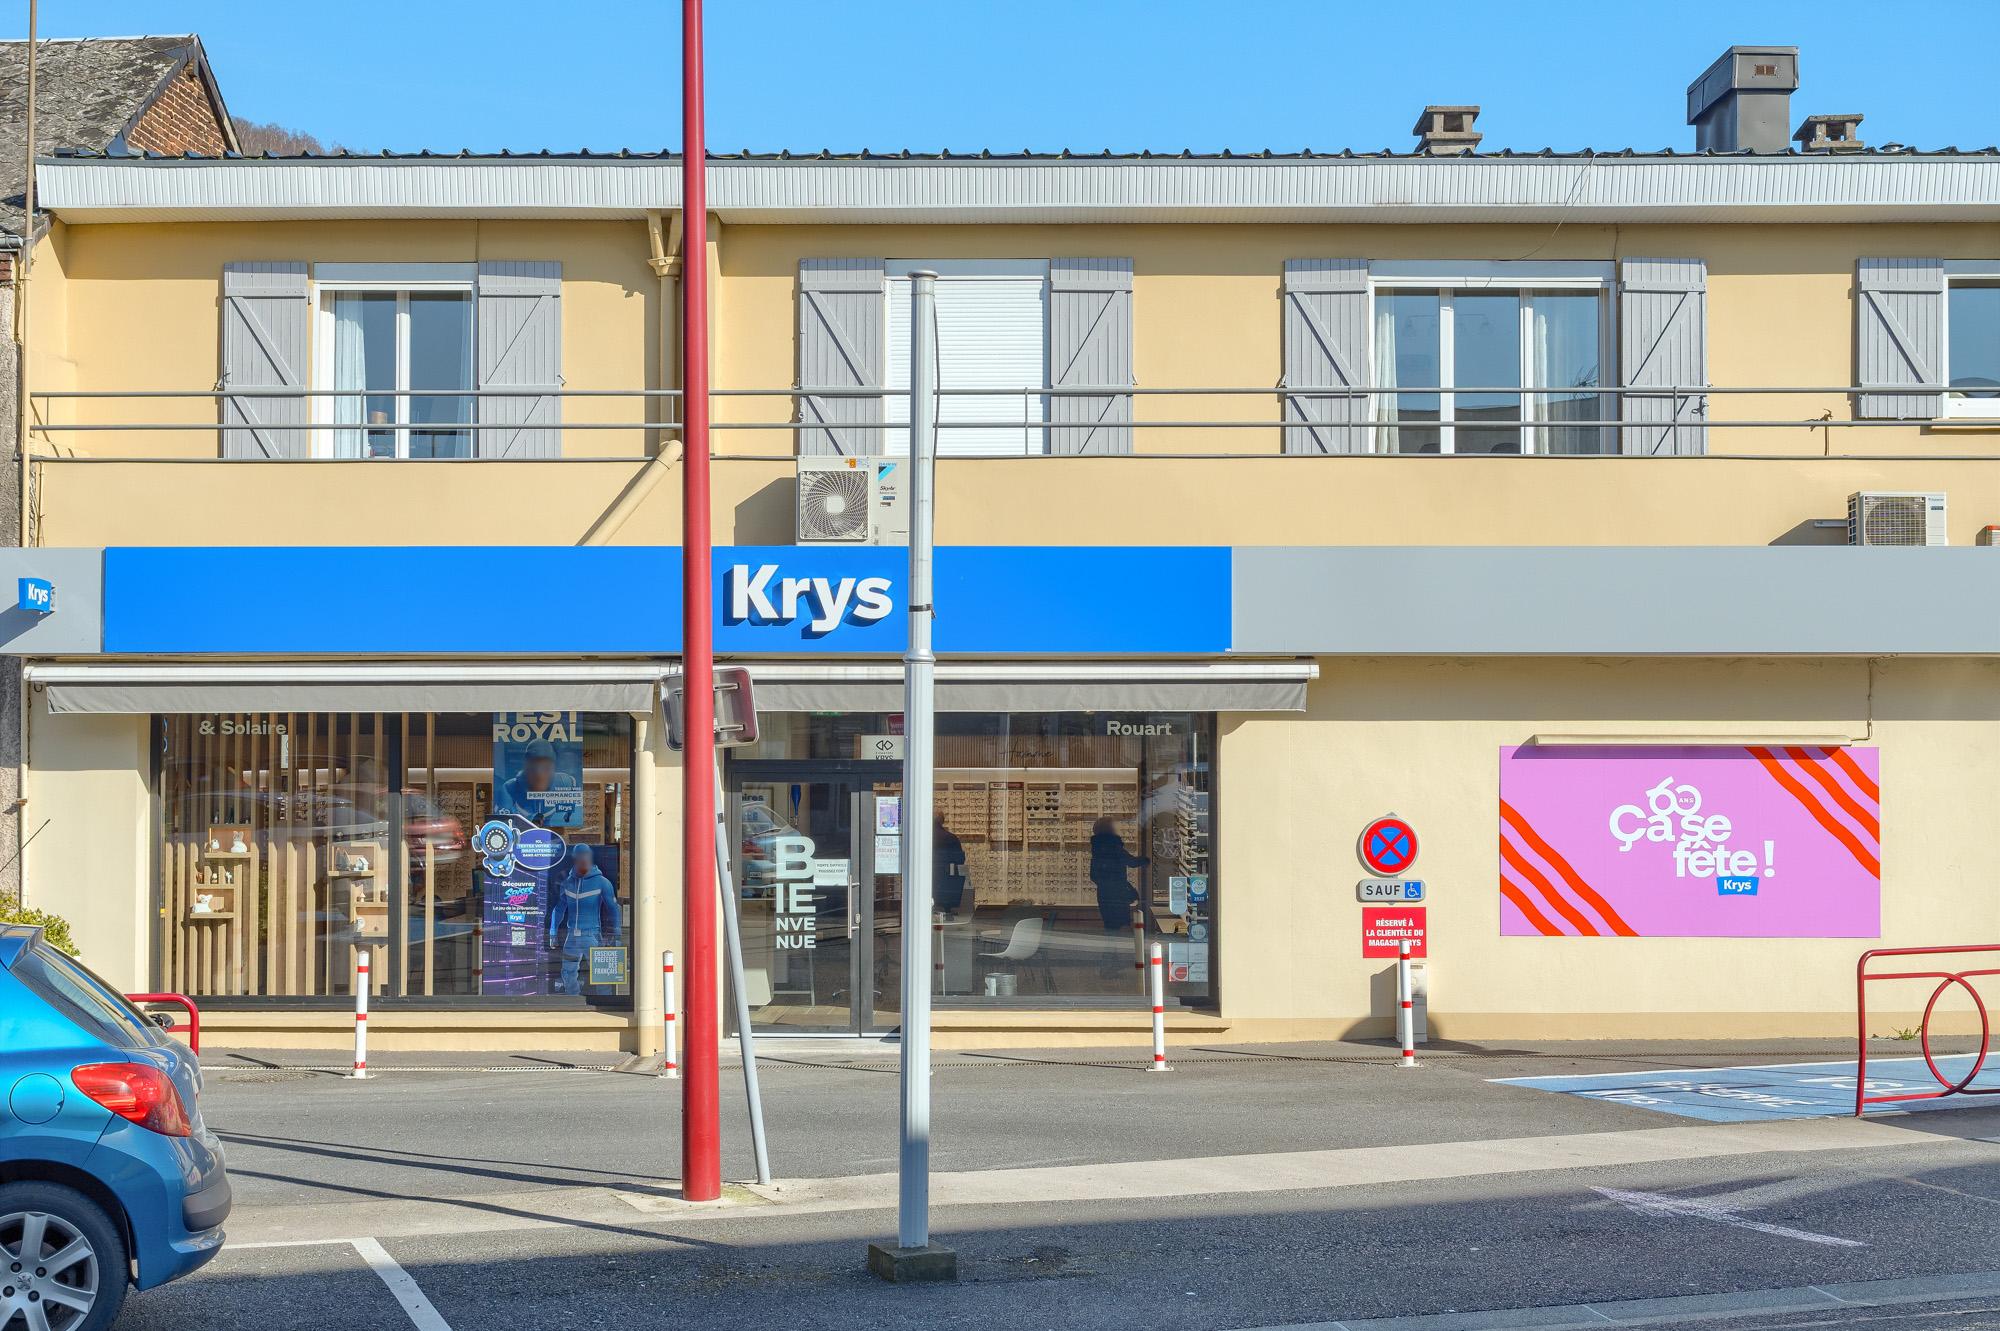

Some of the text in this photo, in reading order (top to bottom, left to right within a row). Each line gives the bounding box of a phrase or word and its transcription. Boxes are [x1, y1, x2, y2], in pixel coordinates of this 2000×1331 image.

[28, 583, 49, 605] Krys
[732, 564, 893, 632] Krys
[199, 720, 287, 735] & Solaire
[493, 724, 583, 743] ROYAL
[1106, 720, 1172, 736] Rouart
[1645, 775, 1702, 816] 60
[1608, 804, 1732, 852] Ça se
[1672, 840, 1757, 878] fête
[1366, 885, 1401, 896] SAUF
[1723, 879, 1752, 892] Krys
[776, 883, 816, 914] IE
[776, 917, 816, 931] NVE
[1375, 917, 1414, 927] RÉSERVÉ À
[1366, 928, 1424, 937] LA CLIENTÈLE DU
[776, 935, 816, 949] NUE
